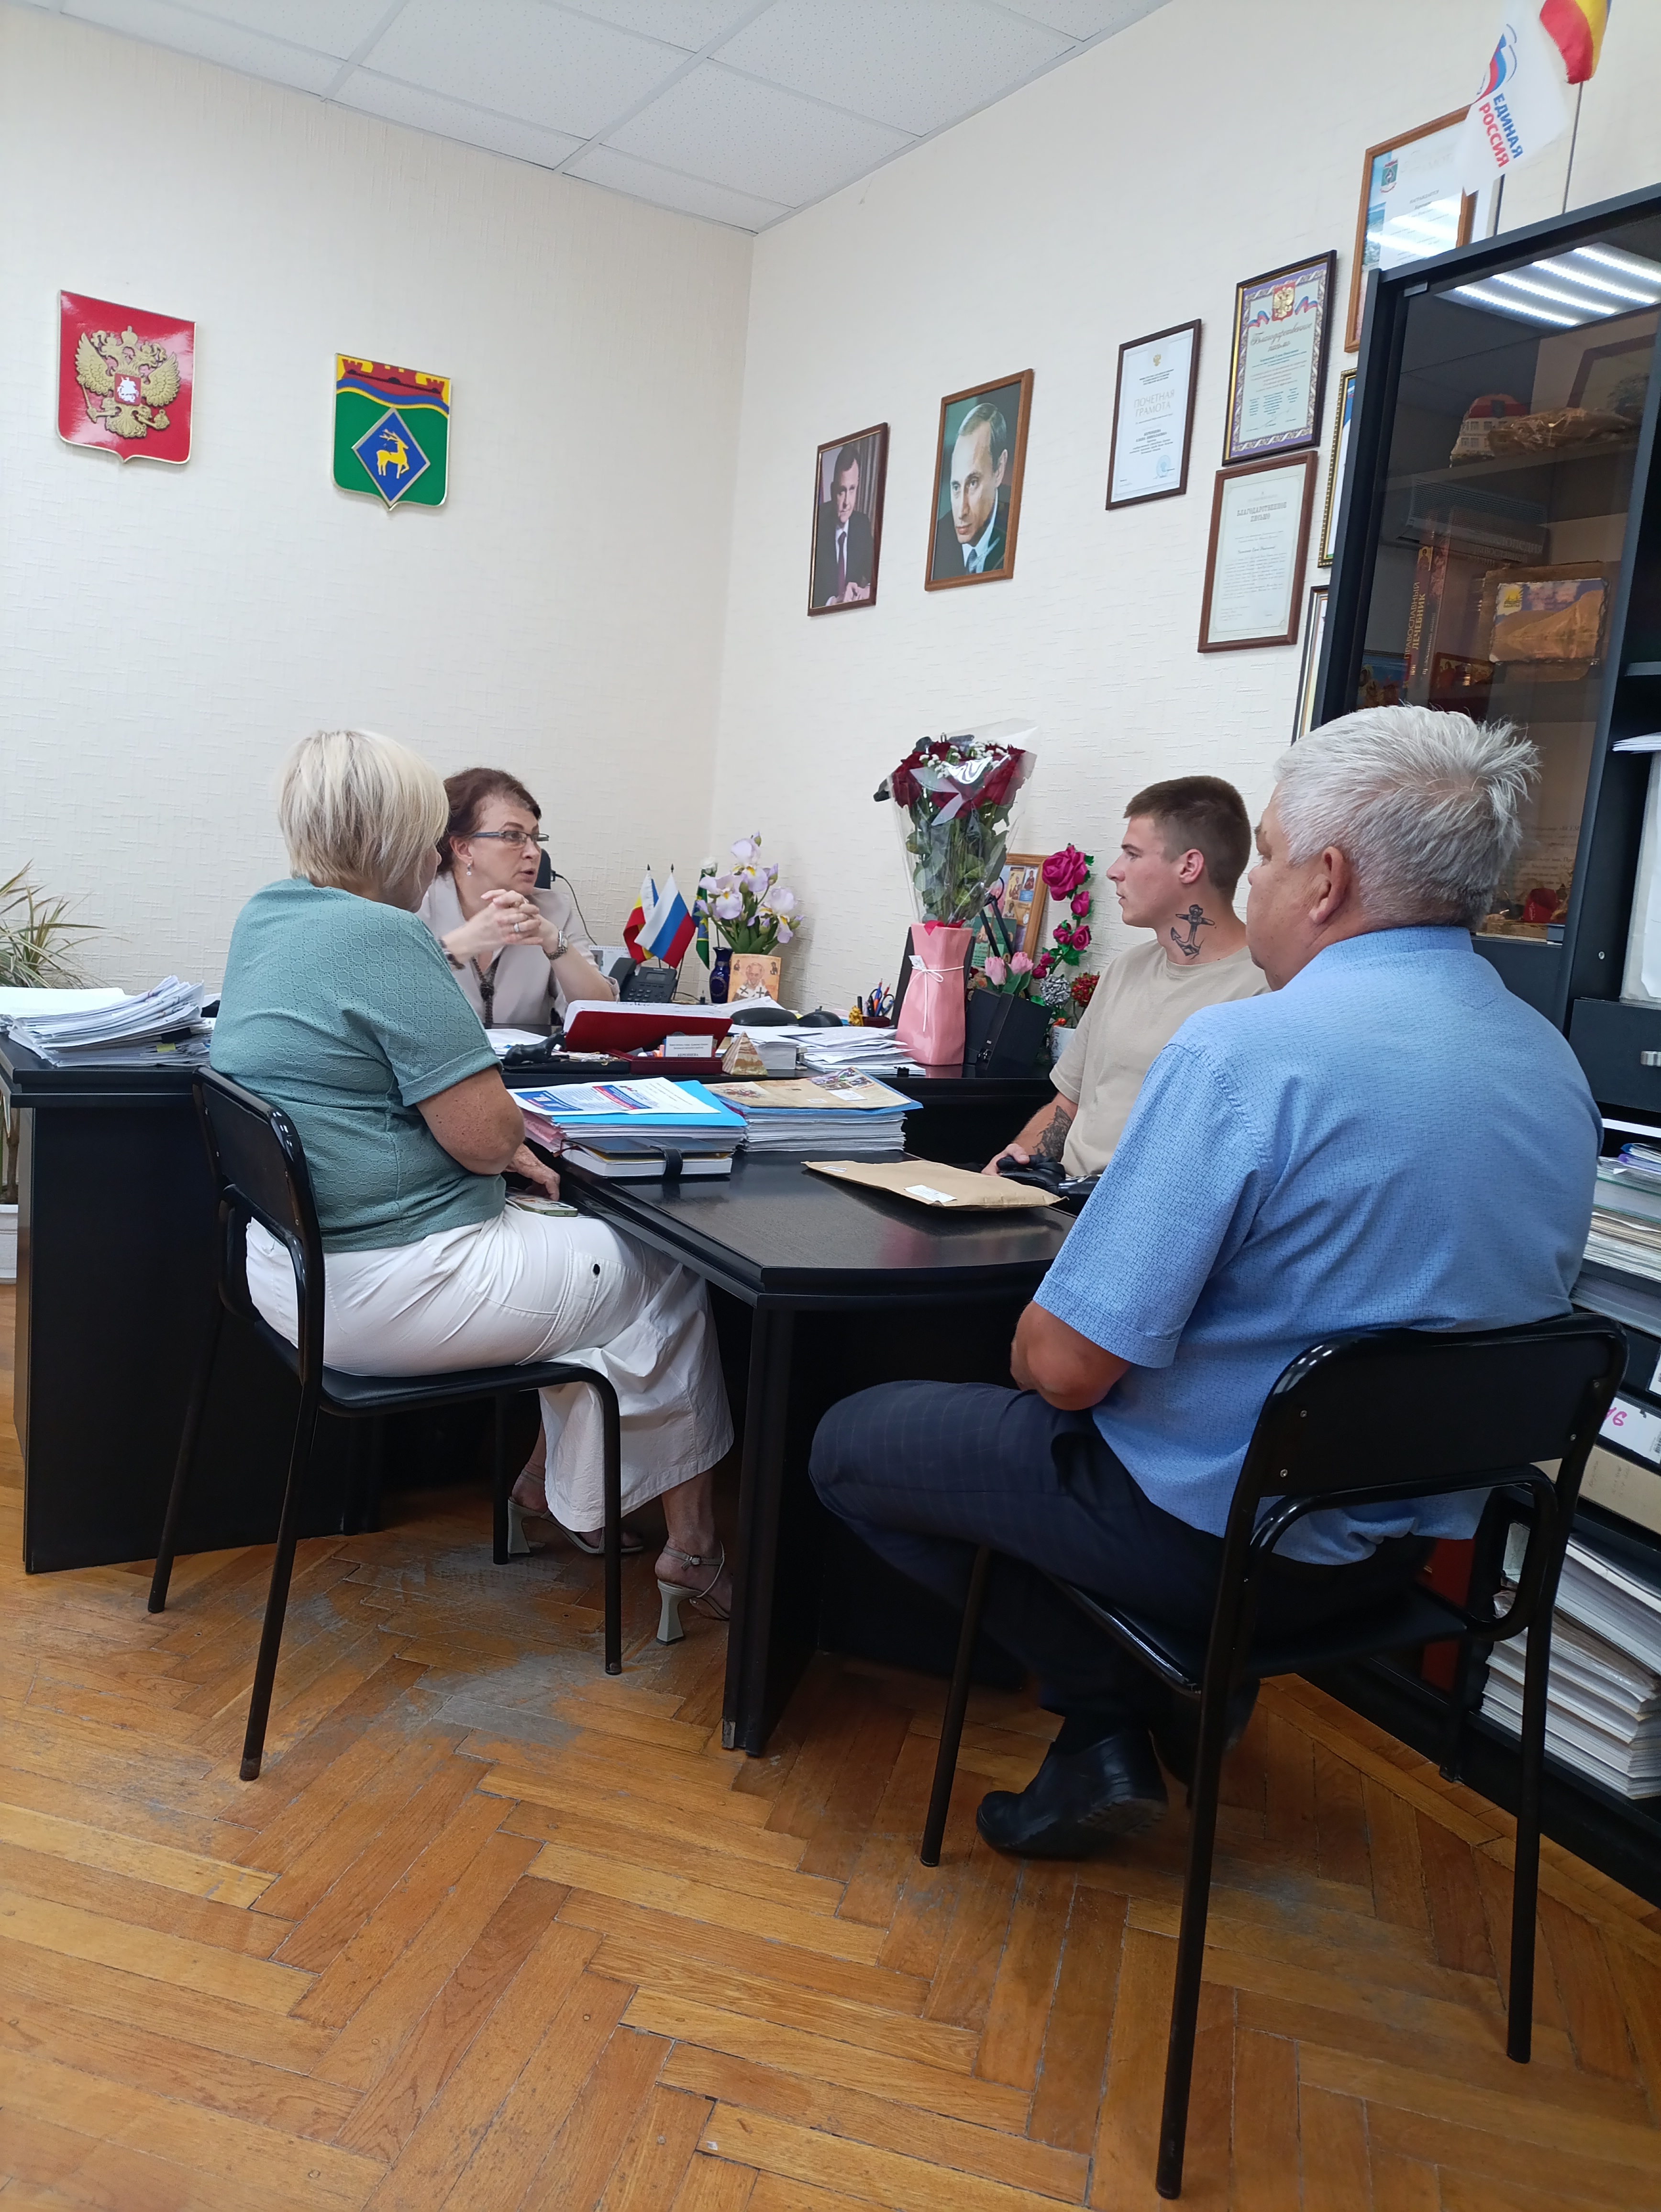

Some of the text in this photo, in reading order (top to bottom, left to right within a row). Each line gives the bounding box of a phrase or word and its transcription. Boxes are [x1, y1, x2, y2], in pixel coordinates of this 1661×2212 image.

[1479, 102, 1509, 167] РОССИЯ
[1493, 93, 1523, 159] ЕДИНАЯ
[1134, 389, 1174, 408] ПОЧЕТНАЯ
[1135, 401, 1171, 417] ГРАМОТА
[1404, 582, 1420, 659] ПРАВОСЛАВНЫЙ
[1411, 593, 1426, 650] ЛЕЧЕБНИК
